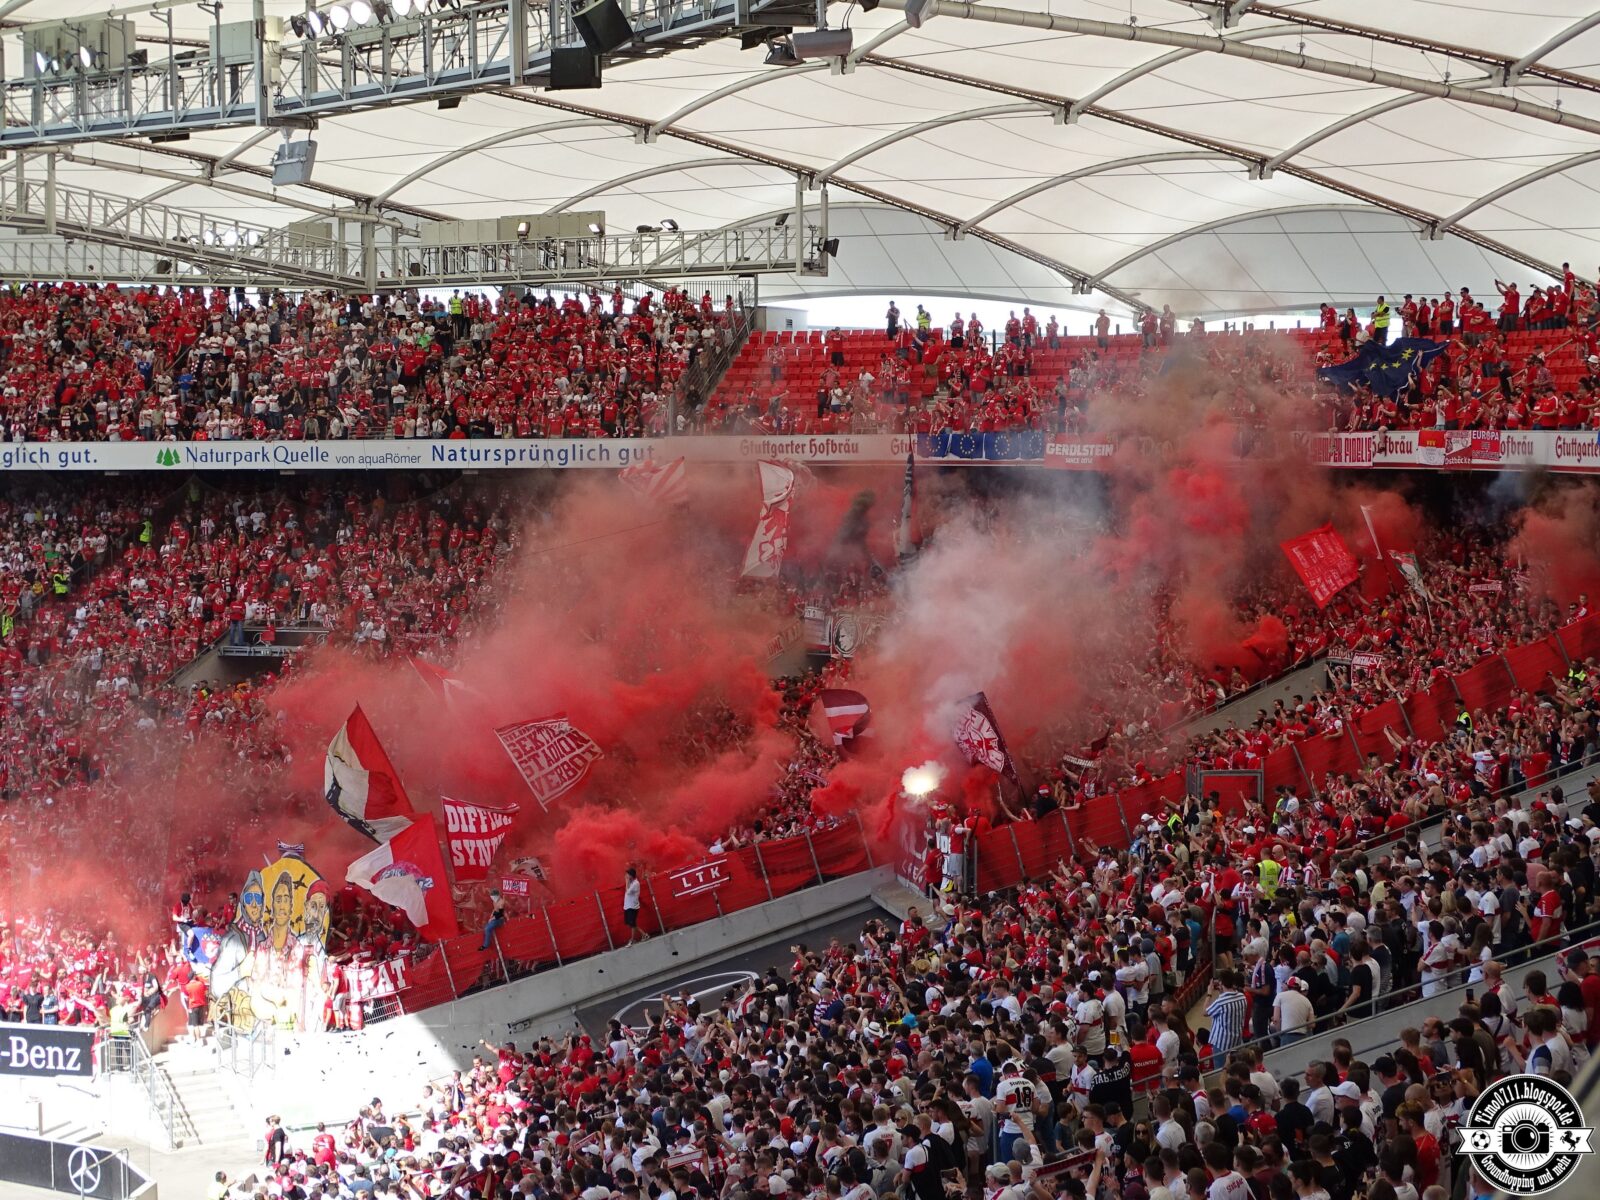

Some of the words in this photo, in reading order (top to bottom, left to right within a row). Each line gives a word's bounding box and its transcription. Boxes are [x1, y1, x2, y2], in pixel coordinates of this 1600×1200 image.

[1472, 430, 1499, 440] EUROPA
[58, 449, 98, 468] gut.
[186, 445, 270, 467] Naturpark
[274, 445, 329, 465] Quelle
[336, 455, 355, 464] von
[359, 452, 421, 468] aquaRömer
[432, 444, 609, 466] Natursprünglich
[1046, 443, 1113, 456] GEROLSTEIN
[520, 731, 592, 778] STADION
[530, 744, 600, 797] VERBOT
[1014, 1086, 1032, 1108] 18
